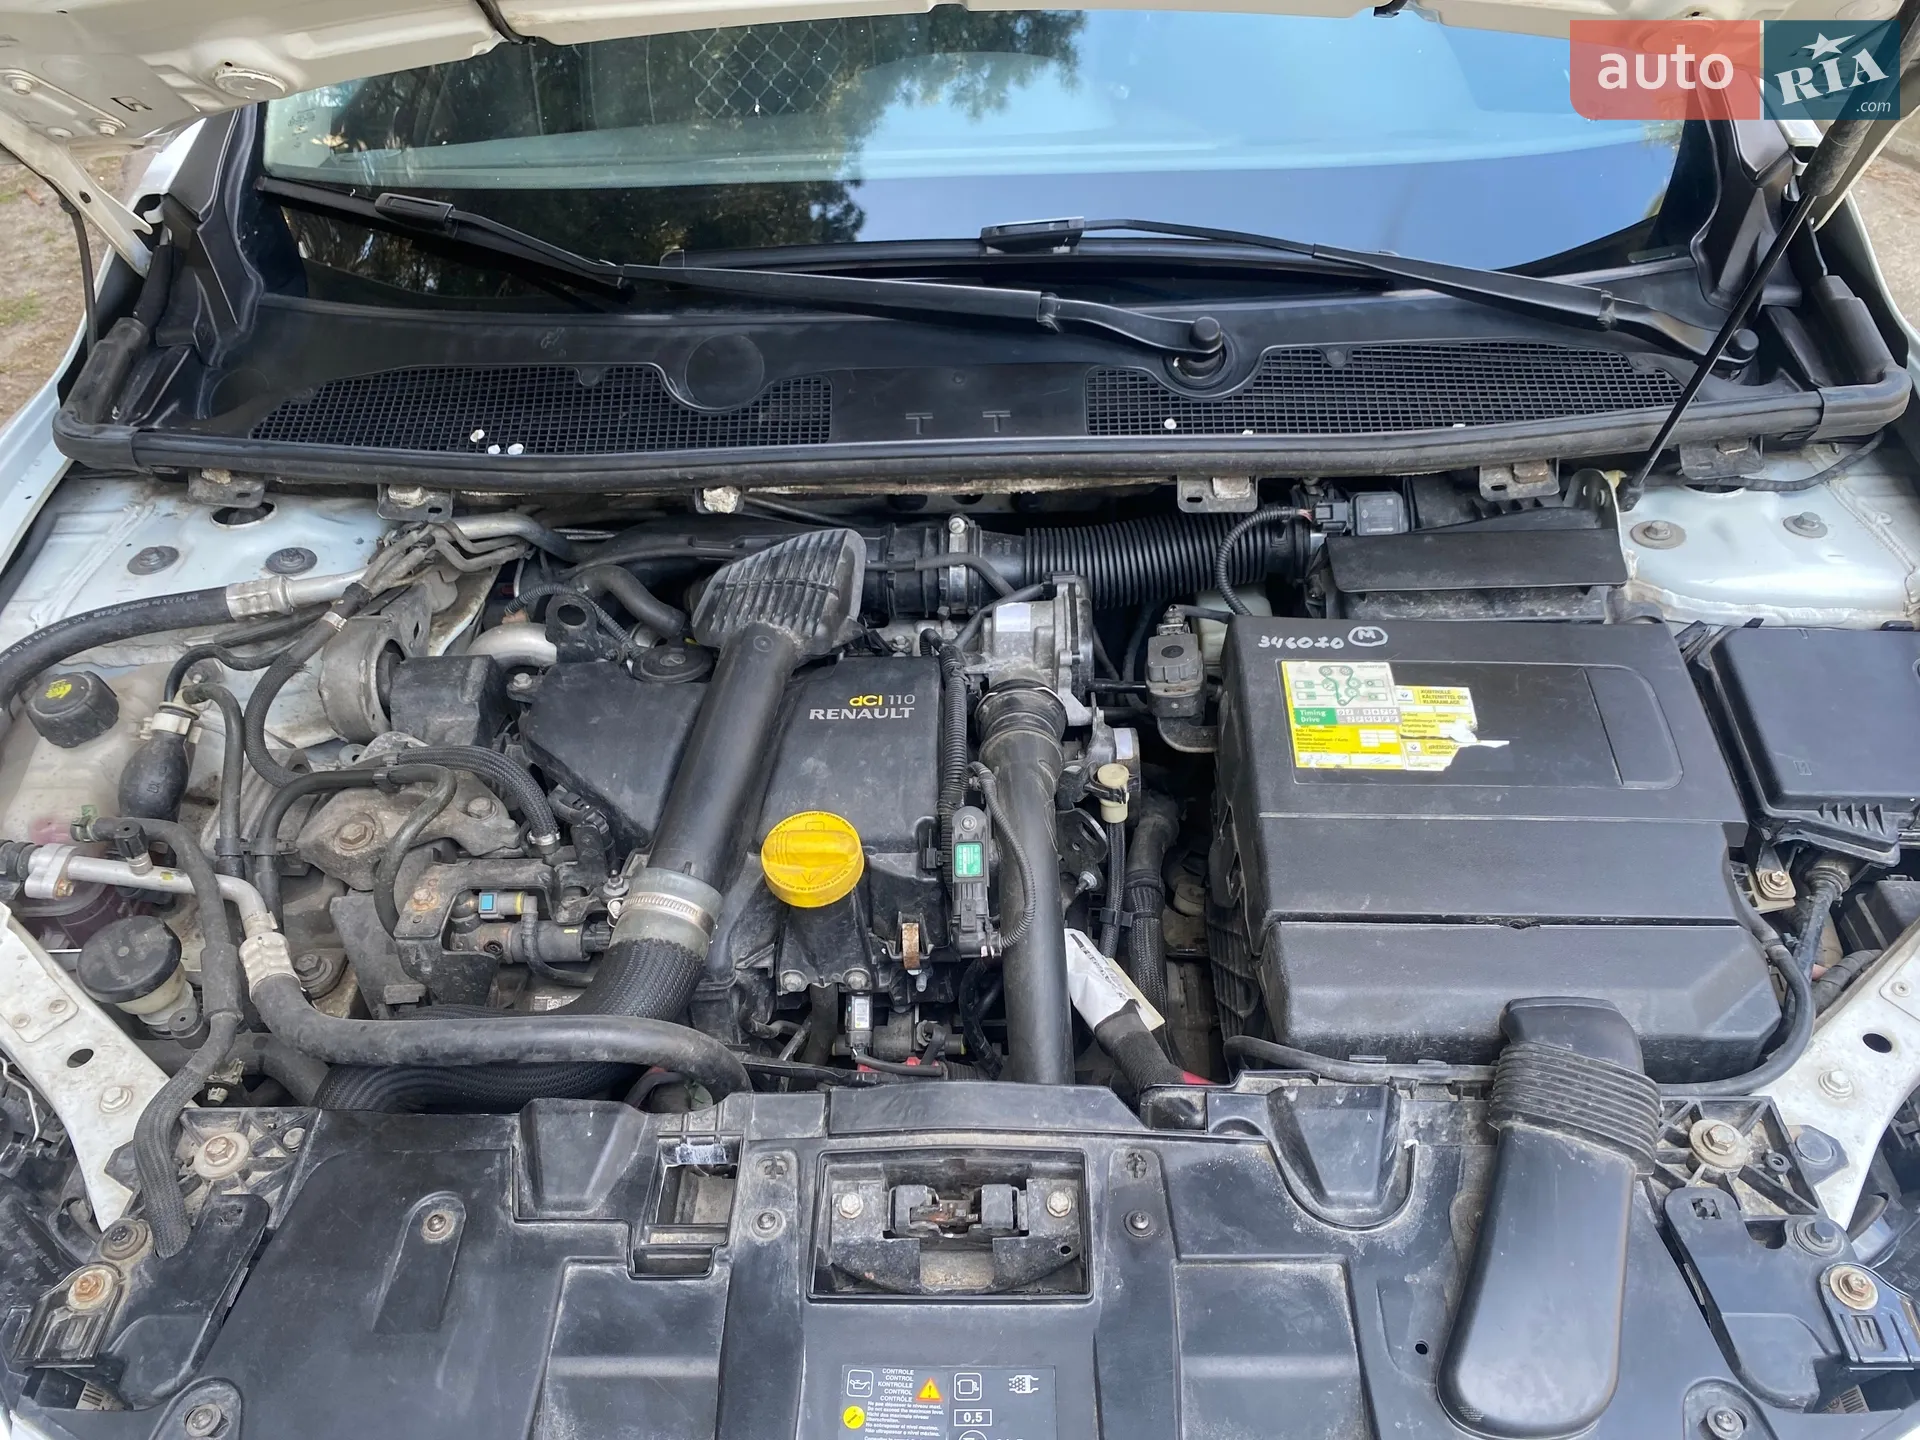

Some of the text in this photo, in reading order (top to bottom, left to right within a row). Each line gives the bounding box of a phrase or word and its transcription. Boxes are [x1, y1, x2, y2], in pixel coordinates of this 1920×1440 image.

[888, 694, 916, 705] 110
[809, 707, 915, 720] RENAULT
[1299, 709, 1327, 717] Timing
[882, 1368, 915, 1376] CONTROLE
[877, 1381, 914, 1389] KONTROLLE
[884, 1388, 912, 1396] CONTROL
[963, 1412, 983, 1424] 0,5
